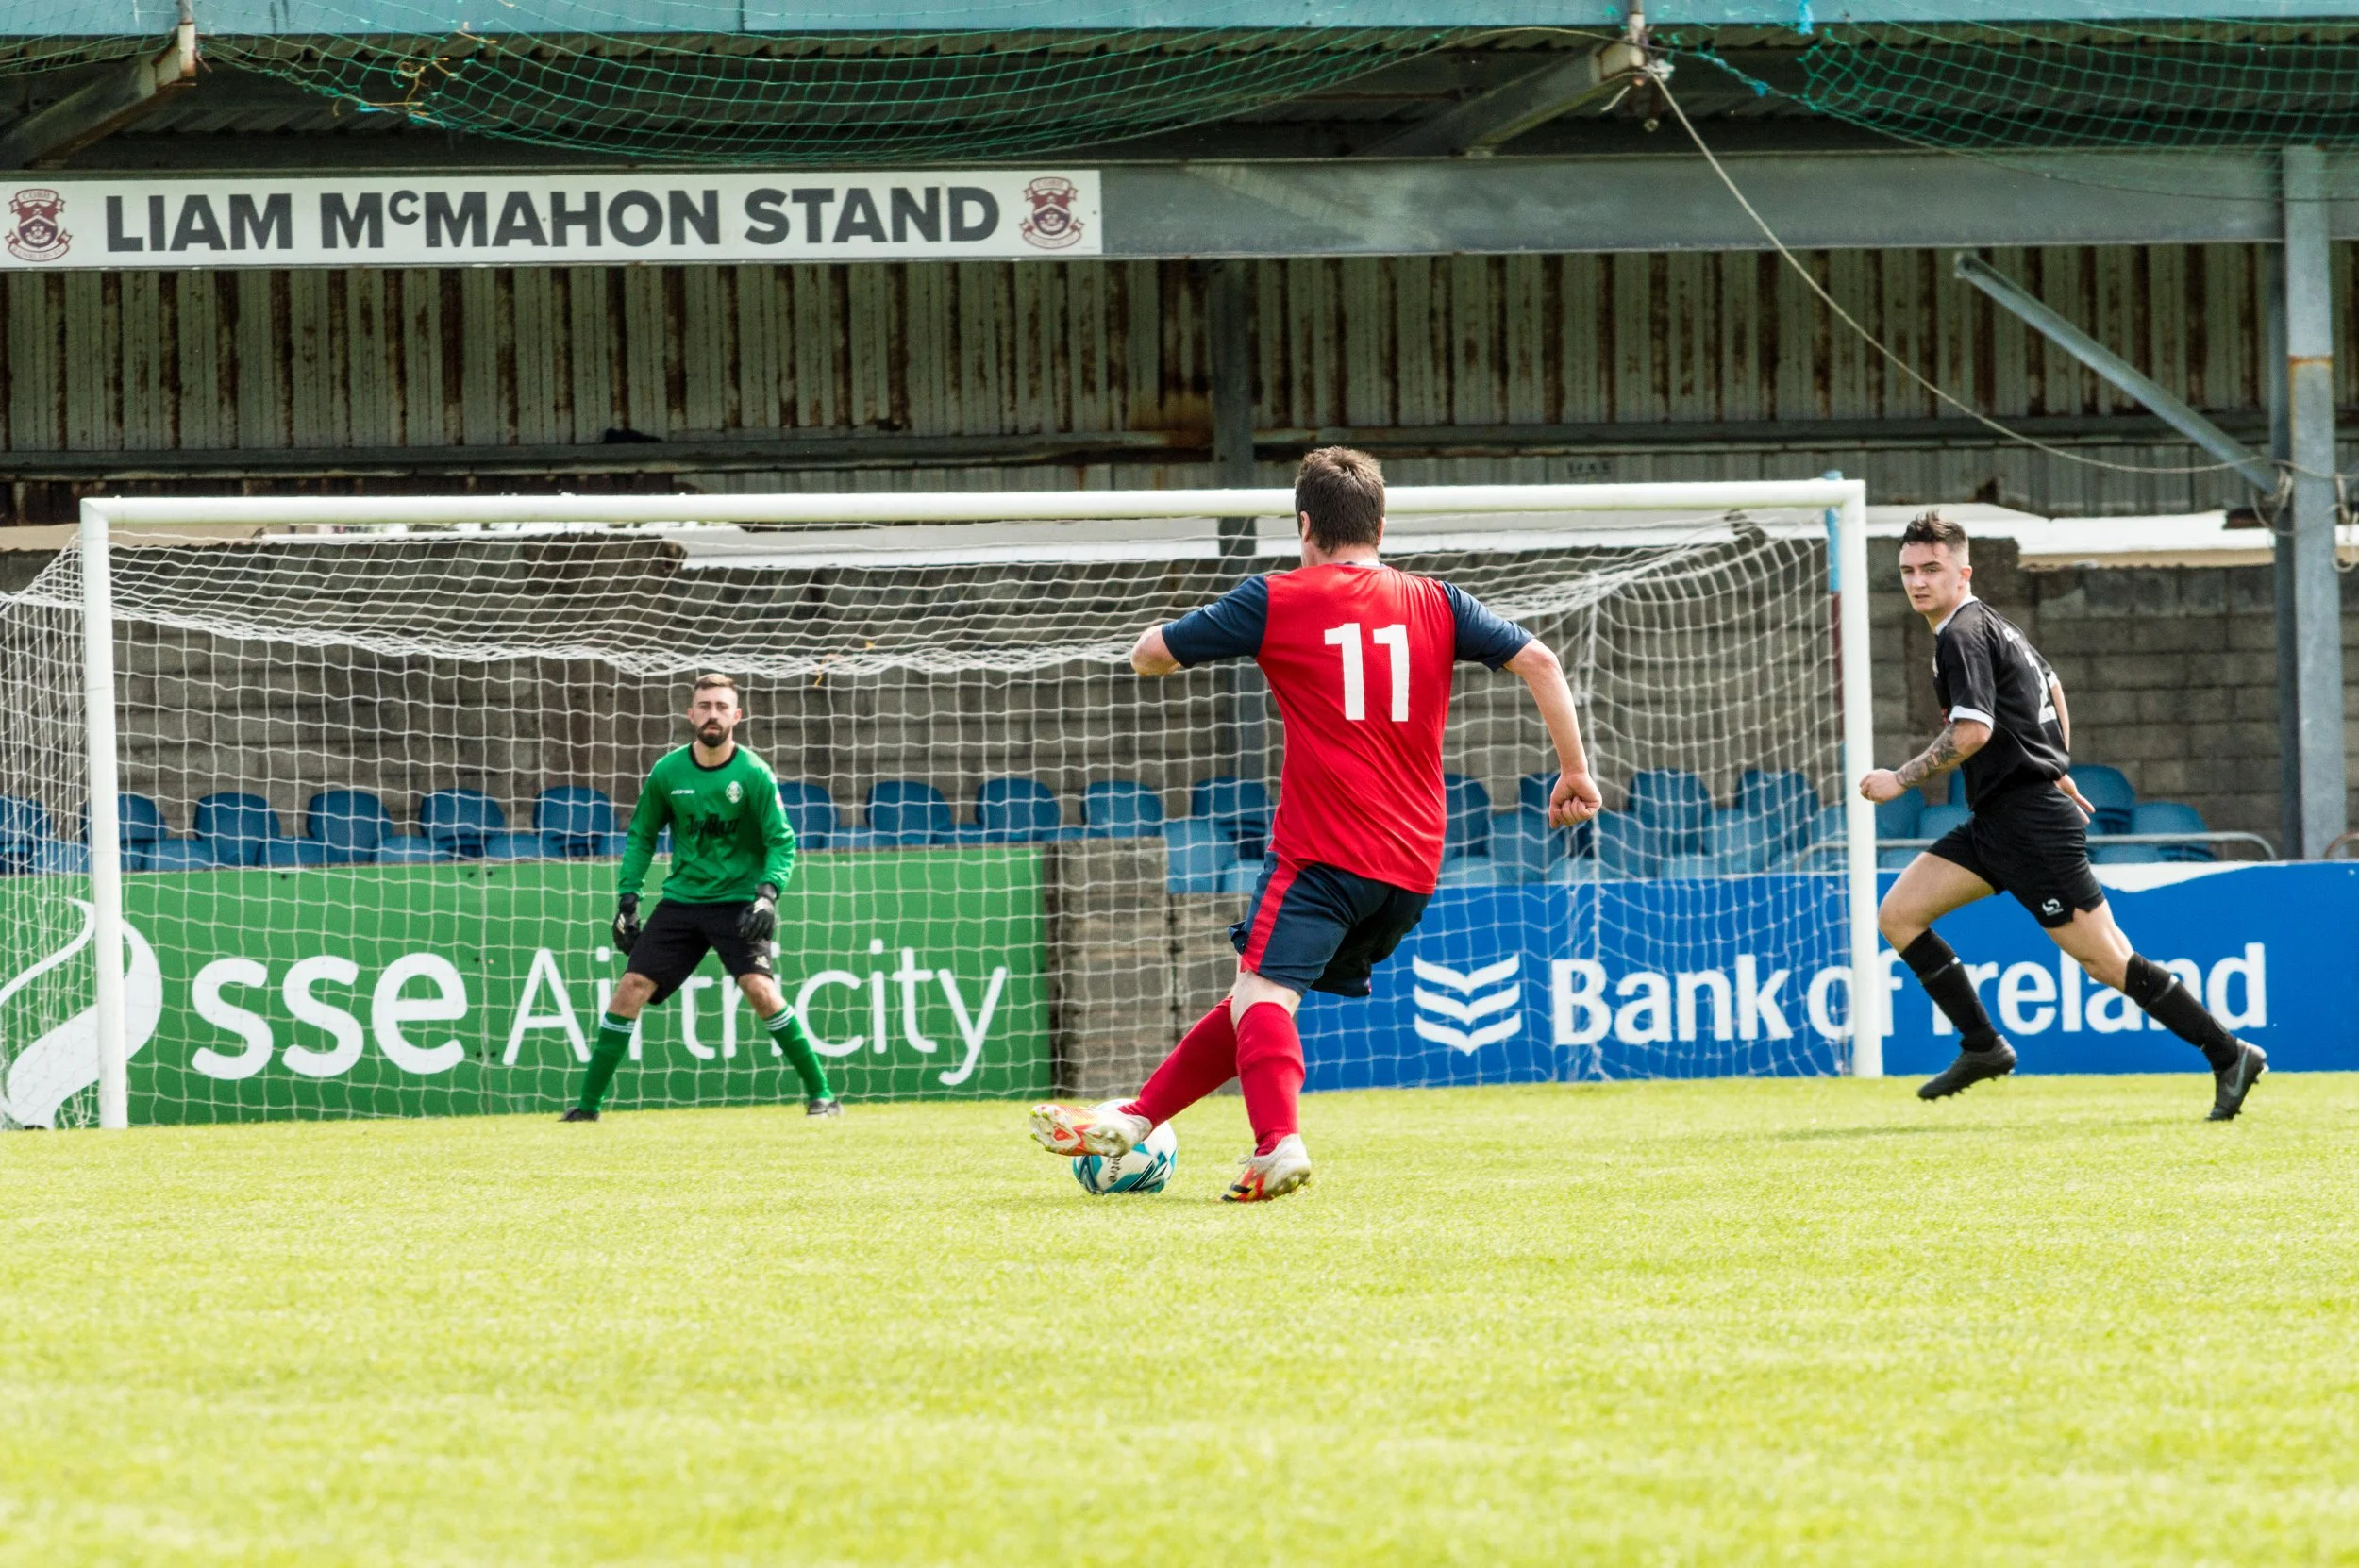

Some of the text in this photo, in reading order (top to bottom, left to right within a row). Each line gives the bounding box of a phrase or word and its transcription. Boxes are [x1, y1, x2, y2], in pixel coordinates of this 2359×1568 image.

[106, 193, 293, 252] LIAM
[744, 186, 1000, 245] STAND
[1324, 623, 1410, 723] 11
[191, 939, 1007, 1086] sse Aitrcity
[1551, 954, 1794, 1046] Bank
[1932, 942, 2267, 1035] reland
